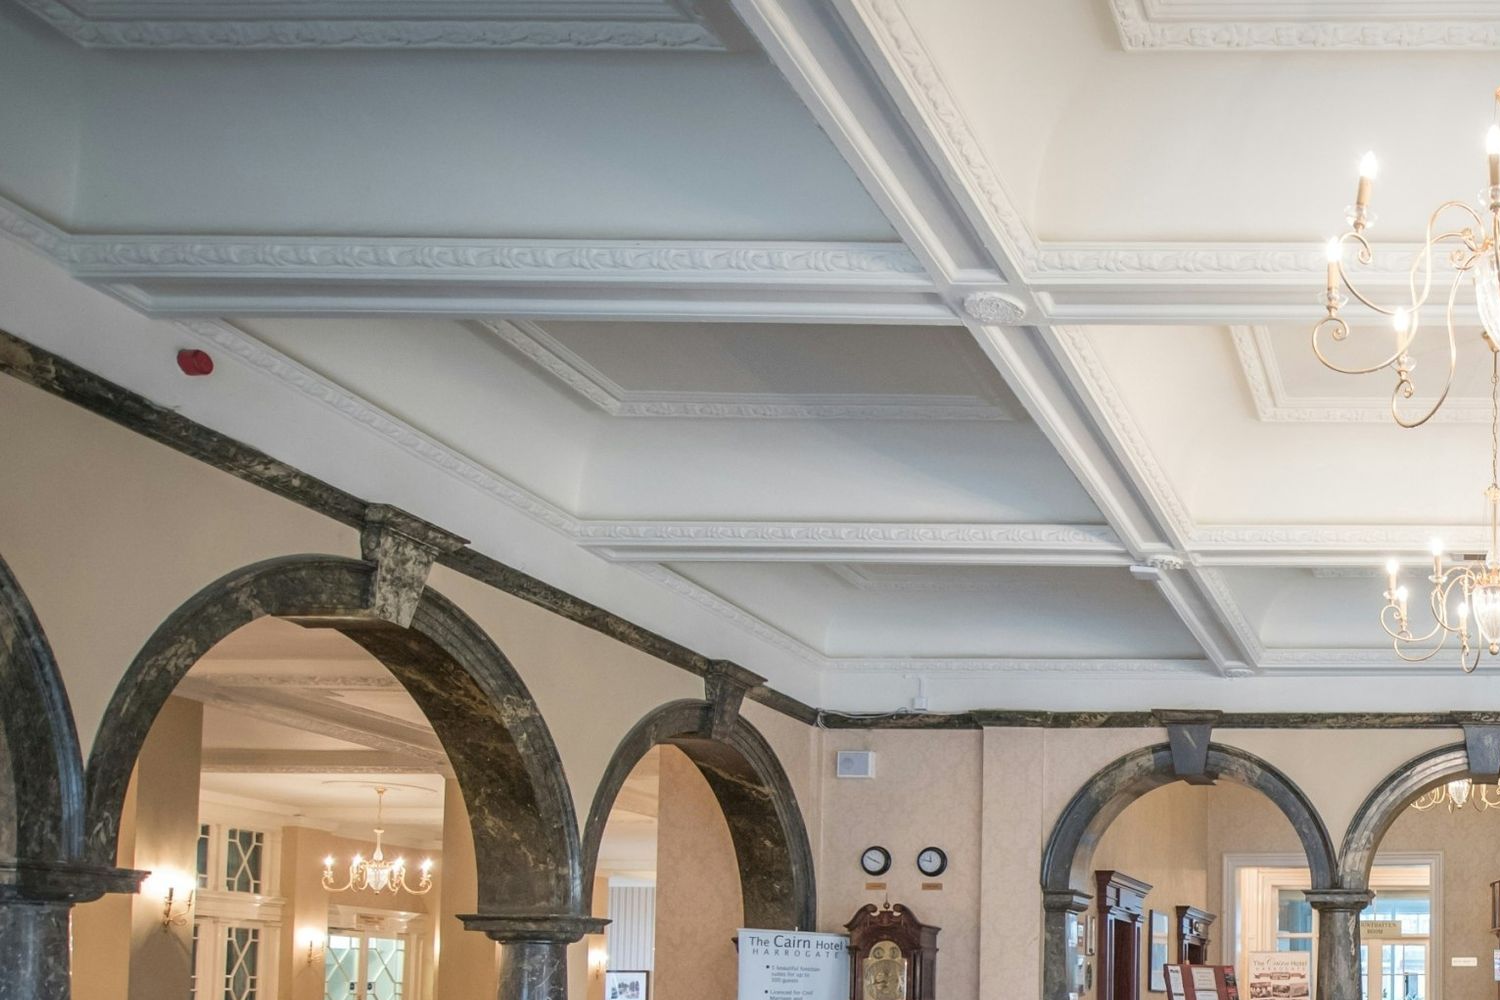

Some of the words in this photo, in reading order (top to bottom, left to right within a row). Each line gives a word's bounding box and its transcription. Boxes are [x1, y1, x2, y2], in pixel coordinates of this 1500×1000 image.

[749, 936, 770, 947] The
[773, 934, 811, 949] Cairn
[815, 940, 843, 951] Hotel
[752, 948, 839, 959] HARROGATE
